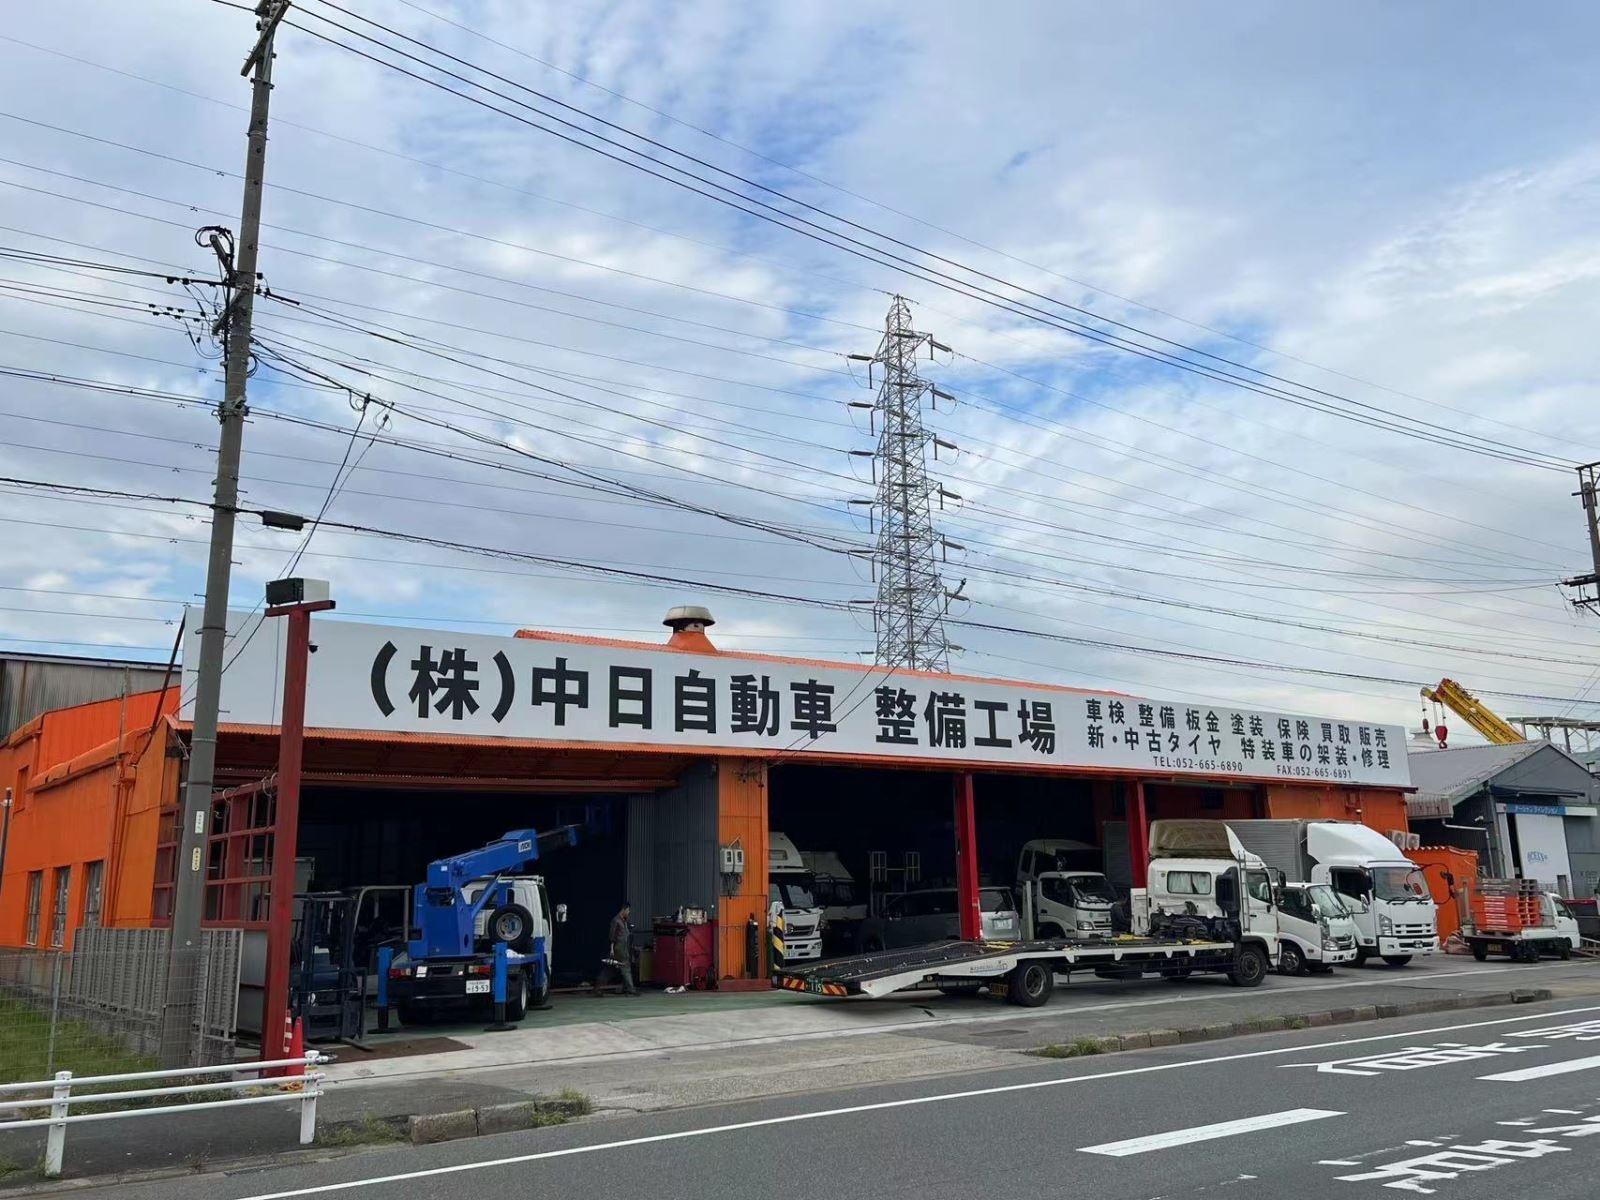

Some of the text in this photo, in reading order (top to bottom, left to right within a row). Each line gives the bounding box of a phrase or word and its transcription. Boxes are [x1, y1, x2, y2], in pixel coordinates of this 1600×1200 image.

[875, 686, 1056, 755] 整備工場
[1086, 698, 1388, 748] 車検 整備 板金 塗装 保険 買取 販売
[1153, 756, 1243, 772] TEL:052-665-6890
[1276, 764, 1352, 779] FAX:052-665-6891
